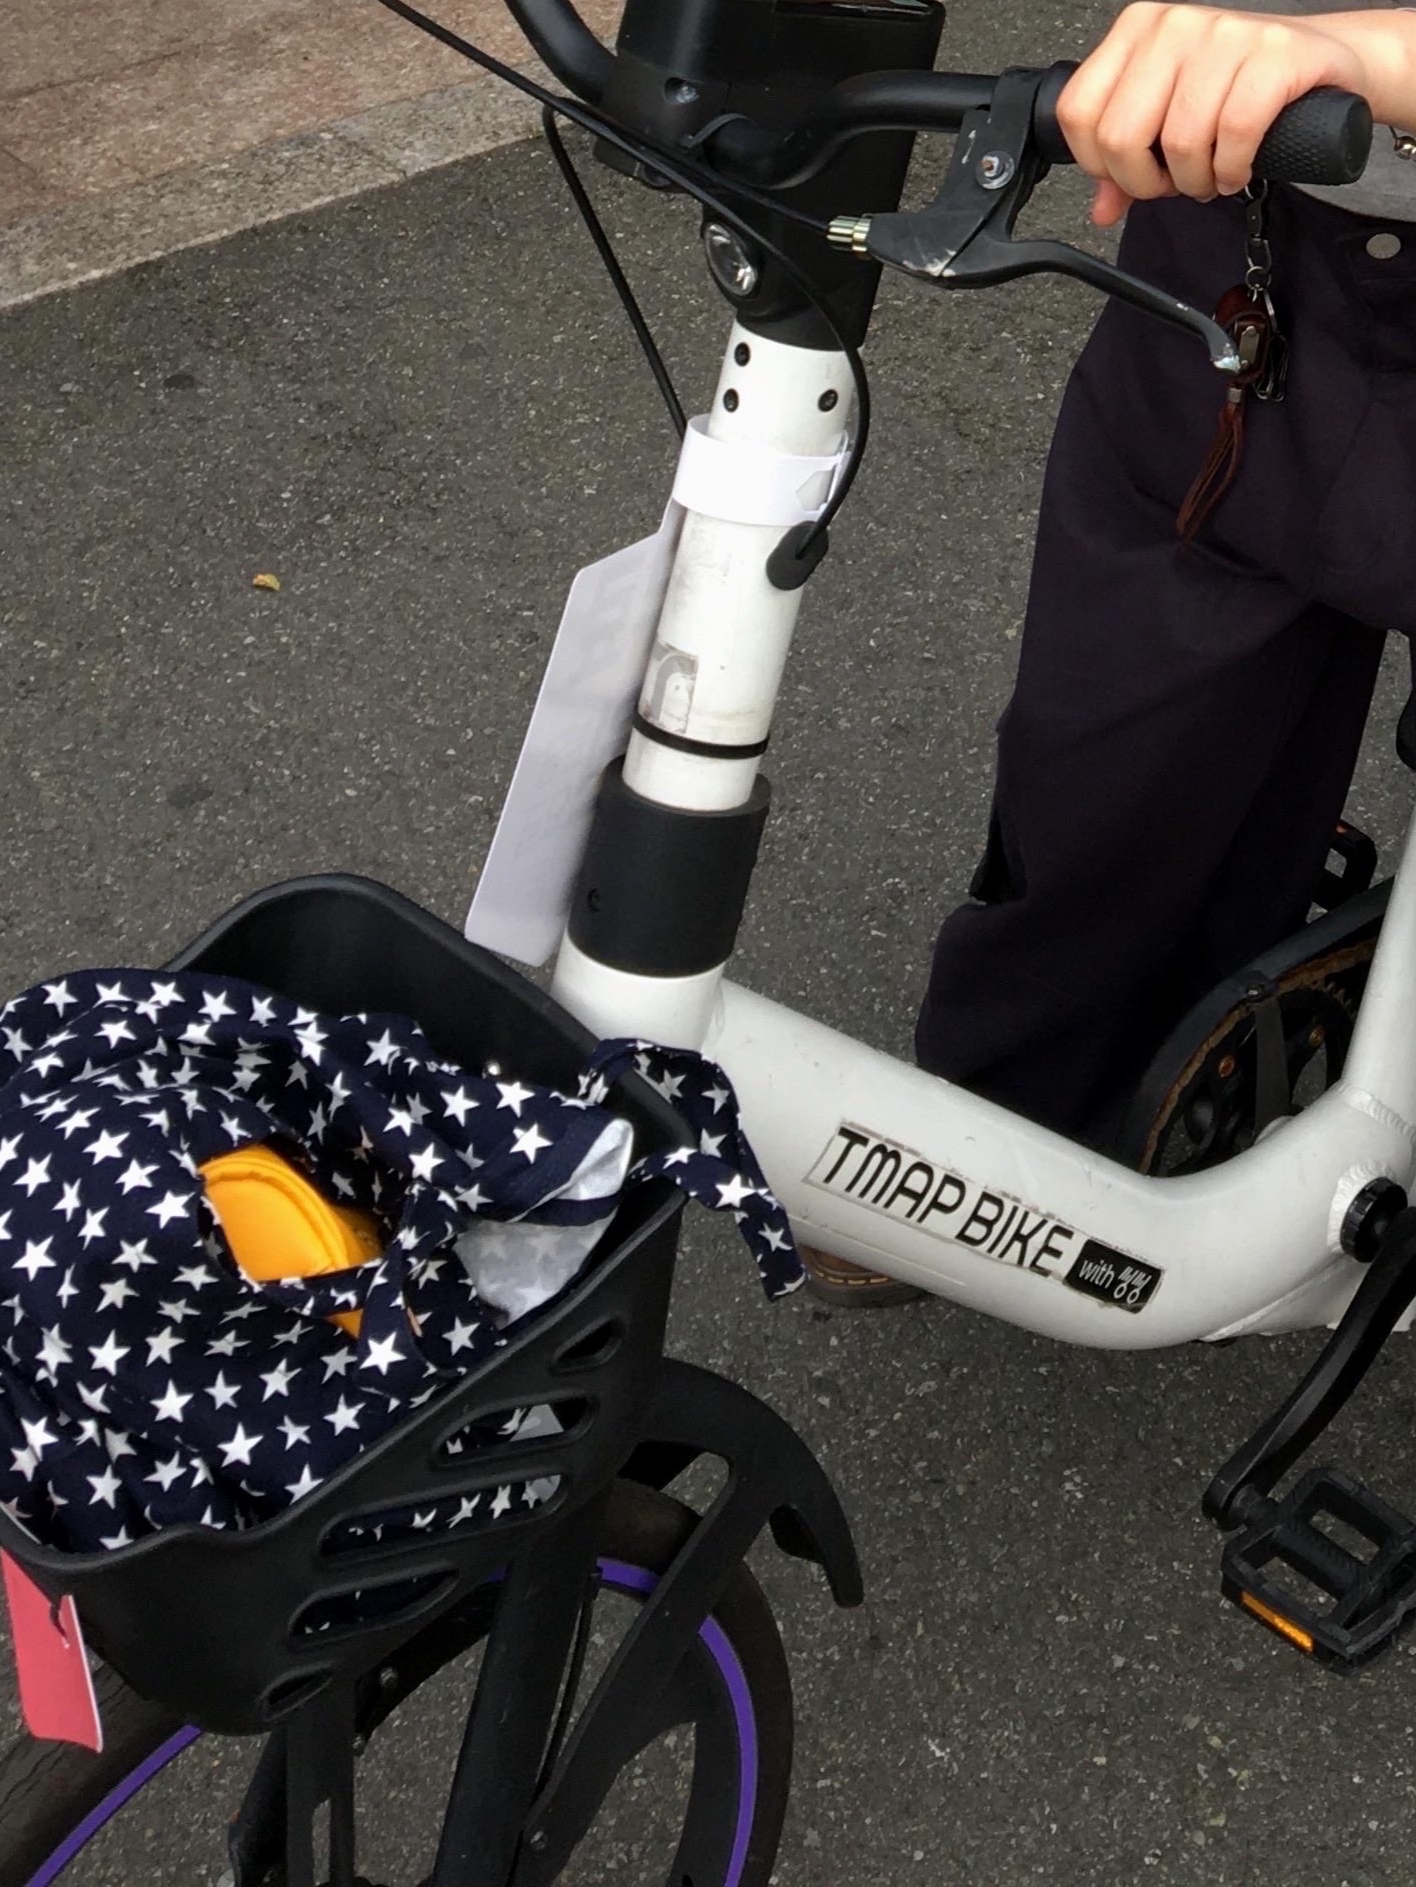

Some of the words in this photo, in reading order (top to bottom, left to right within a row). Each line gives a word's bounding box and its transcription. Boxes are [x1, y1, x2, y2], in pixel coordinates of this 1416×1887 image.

[823, 1126, 966, 1223] TMAP
[954, 1190, 1074, 1277] BIKE
[1079, 1259, 1115, 1289] with
